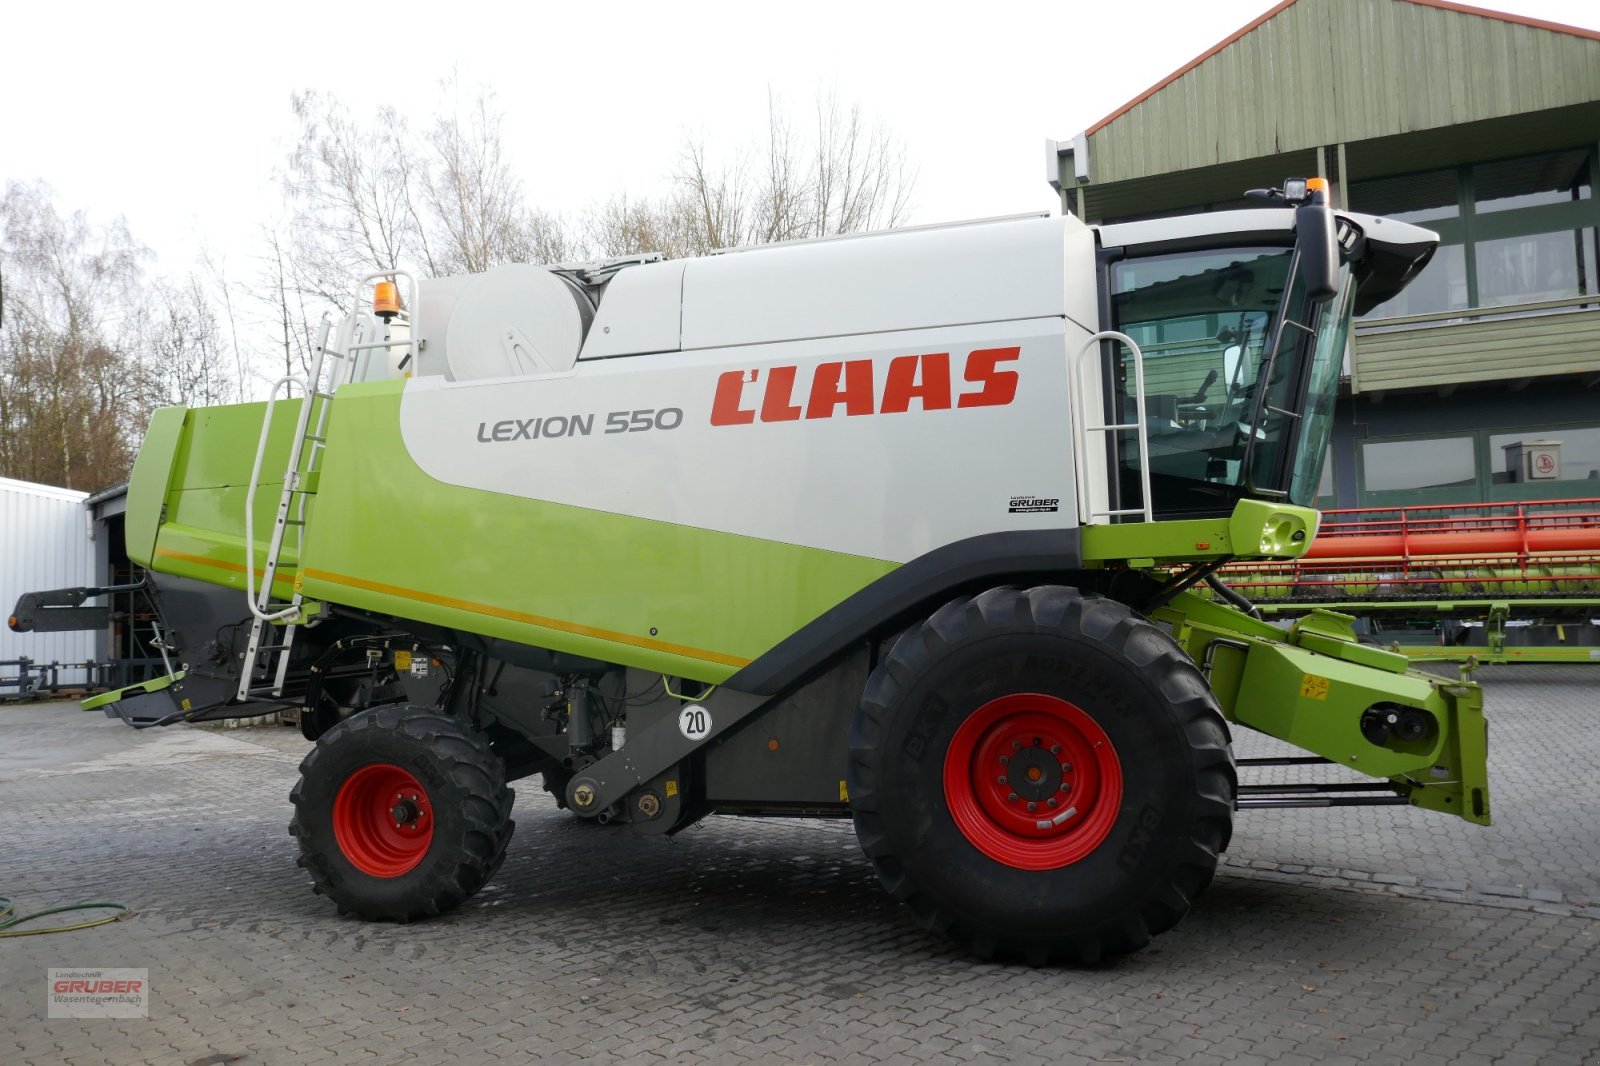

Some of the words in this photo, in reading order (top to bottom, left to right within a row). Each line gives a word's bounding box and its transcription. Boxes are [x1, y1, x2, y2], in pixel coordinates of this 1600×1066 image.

[710, 346, 1021, 426] CLAAS
[477, 413, 595, 443] LEXION
[604, 407, 684, 434] 550
[685, 711, 706, 734] 20
